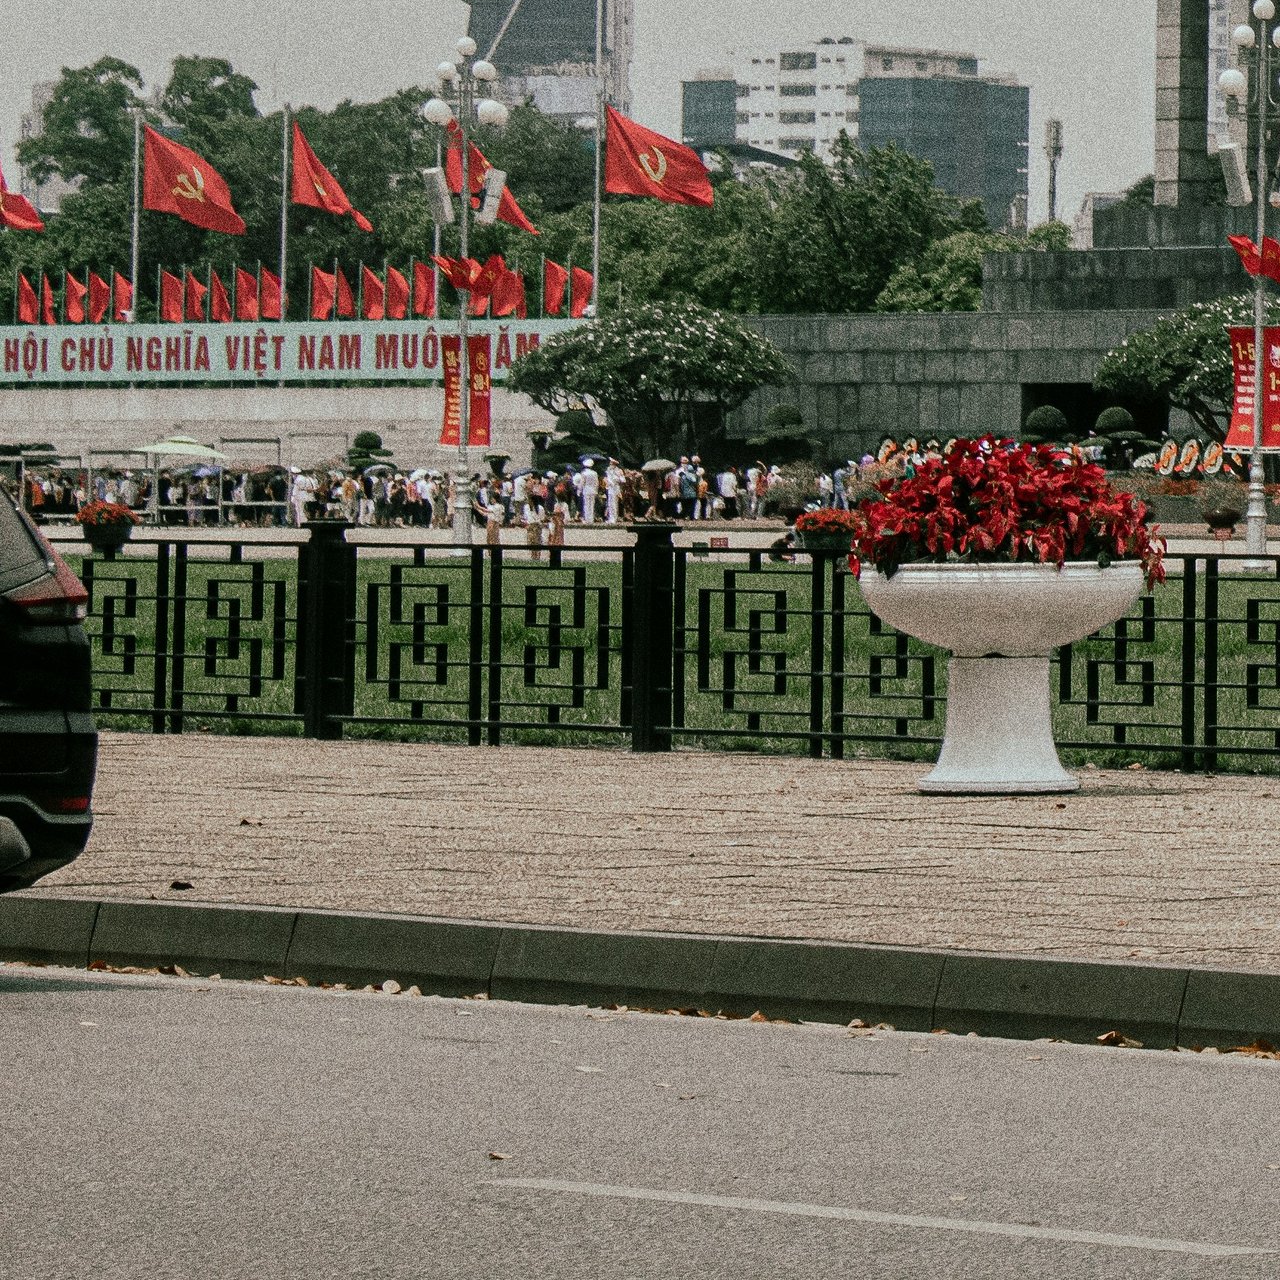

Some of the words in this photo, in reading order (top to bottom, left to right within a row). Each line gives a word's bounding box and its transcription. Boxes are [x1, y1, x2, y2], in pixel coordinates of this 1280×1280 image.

[5, 330, 48, 379] HỘI
[62, 325, 114, 371] CHỦ
[127, 328, 210, 370] NGHĨA
[226, 328, 284, 377] VIỆT
[298, 334, 362, 369] NAM
[377, 325, 439, 369] MUÔ
